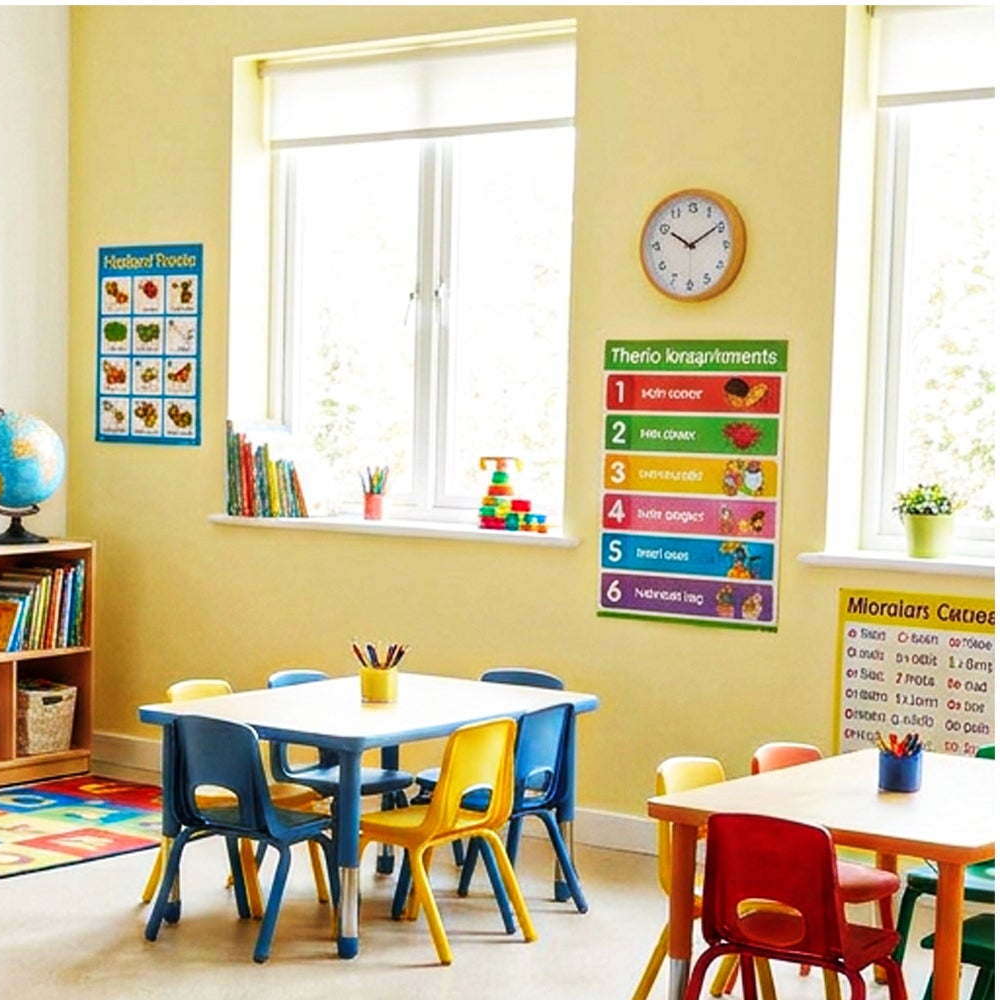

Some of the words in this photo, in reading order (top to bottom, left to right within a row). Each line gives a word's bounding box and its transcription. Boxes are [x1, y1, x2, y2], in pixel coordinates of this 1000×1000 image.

[616, 381, 624, 403] 1
[612, 421, 626, 444] 2
[610, 461, 626, 483] 3
[608, 499, 625, 523] 4
[608, 540, 622, 562] 5
[607, 580, 622, 602] 6
